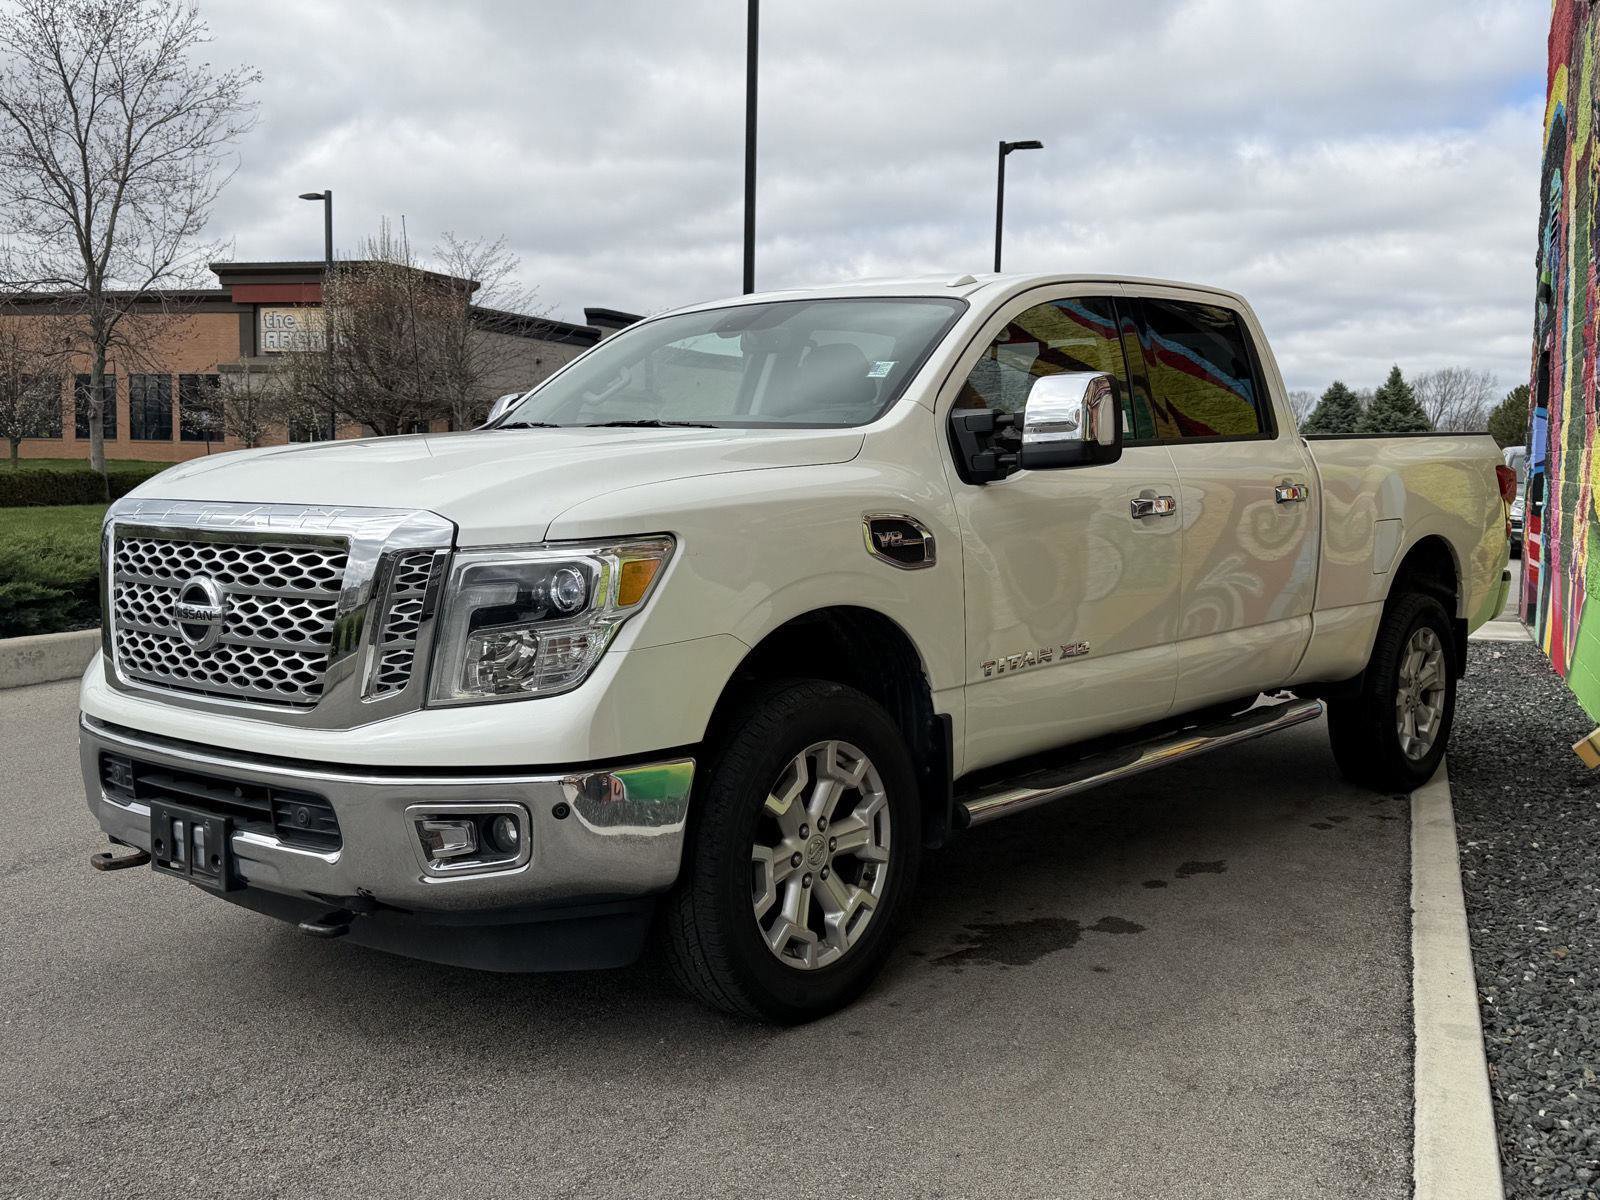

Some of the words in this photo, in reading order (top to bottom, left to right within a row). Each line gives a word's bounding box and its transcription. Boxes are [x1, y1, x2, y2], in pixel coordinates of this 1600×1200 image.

[264, 311, 295, 328] the
[264, 331, 346, 351] AREN
[175, 607, 213, 621] NISSAN
[980, 648, 1053, 677] TITAN
